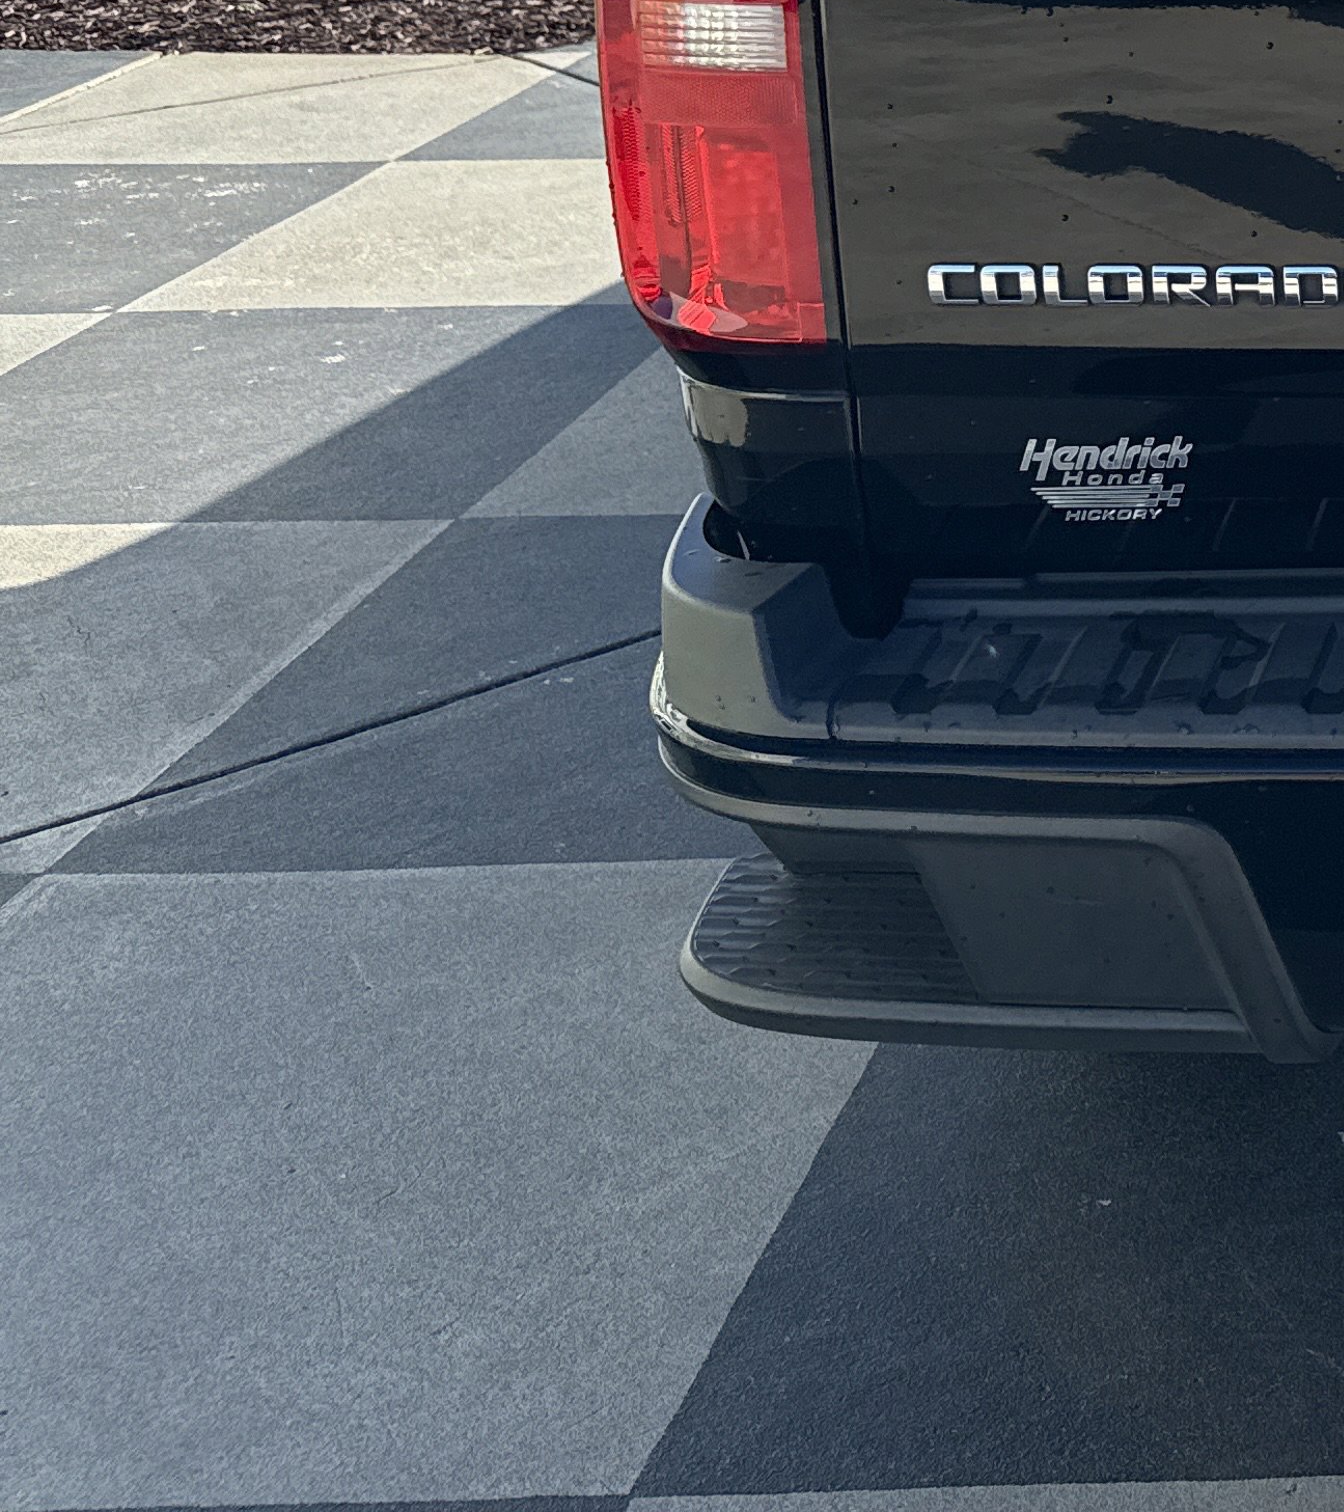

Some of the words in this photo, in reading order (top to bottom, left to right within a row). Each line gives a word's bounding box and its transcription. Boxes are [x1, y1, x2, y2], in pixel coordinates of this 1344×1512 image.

[1019, 436, 1193, 481] Hendrick
[1061, 469, 1164, 485] Honda
[1064, 508, 1163, 522] HICKORY
